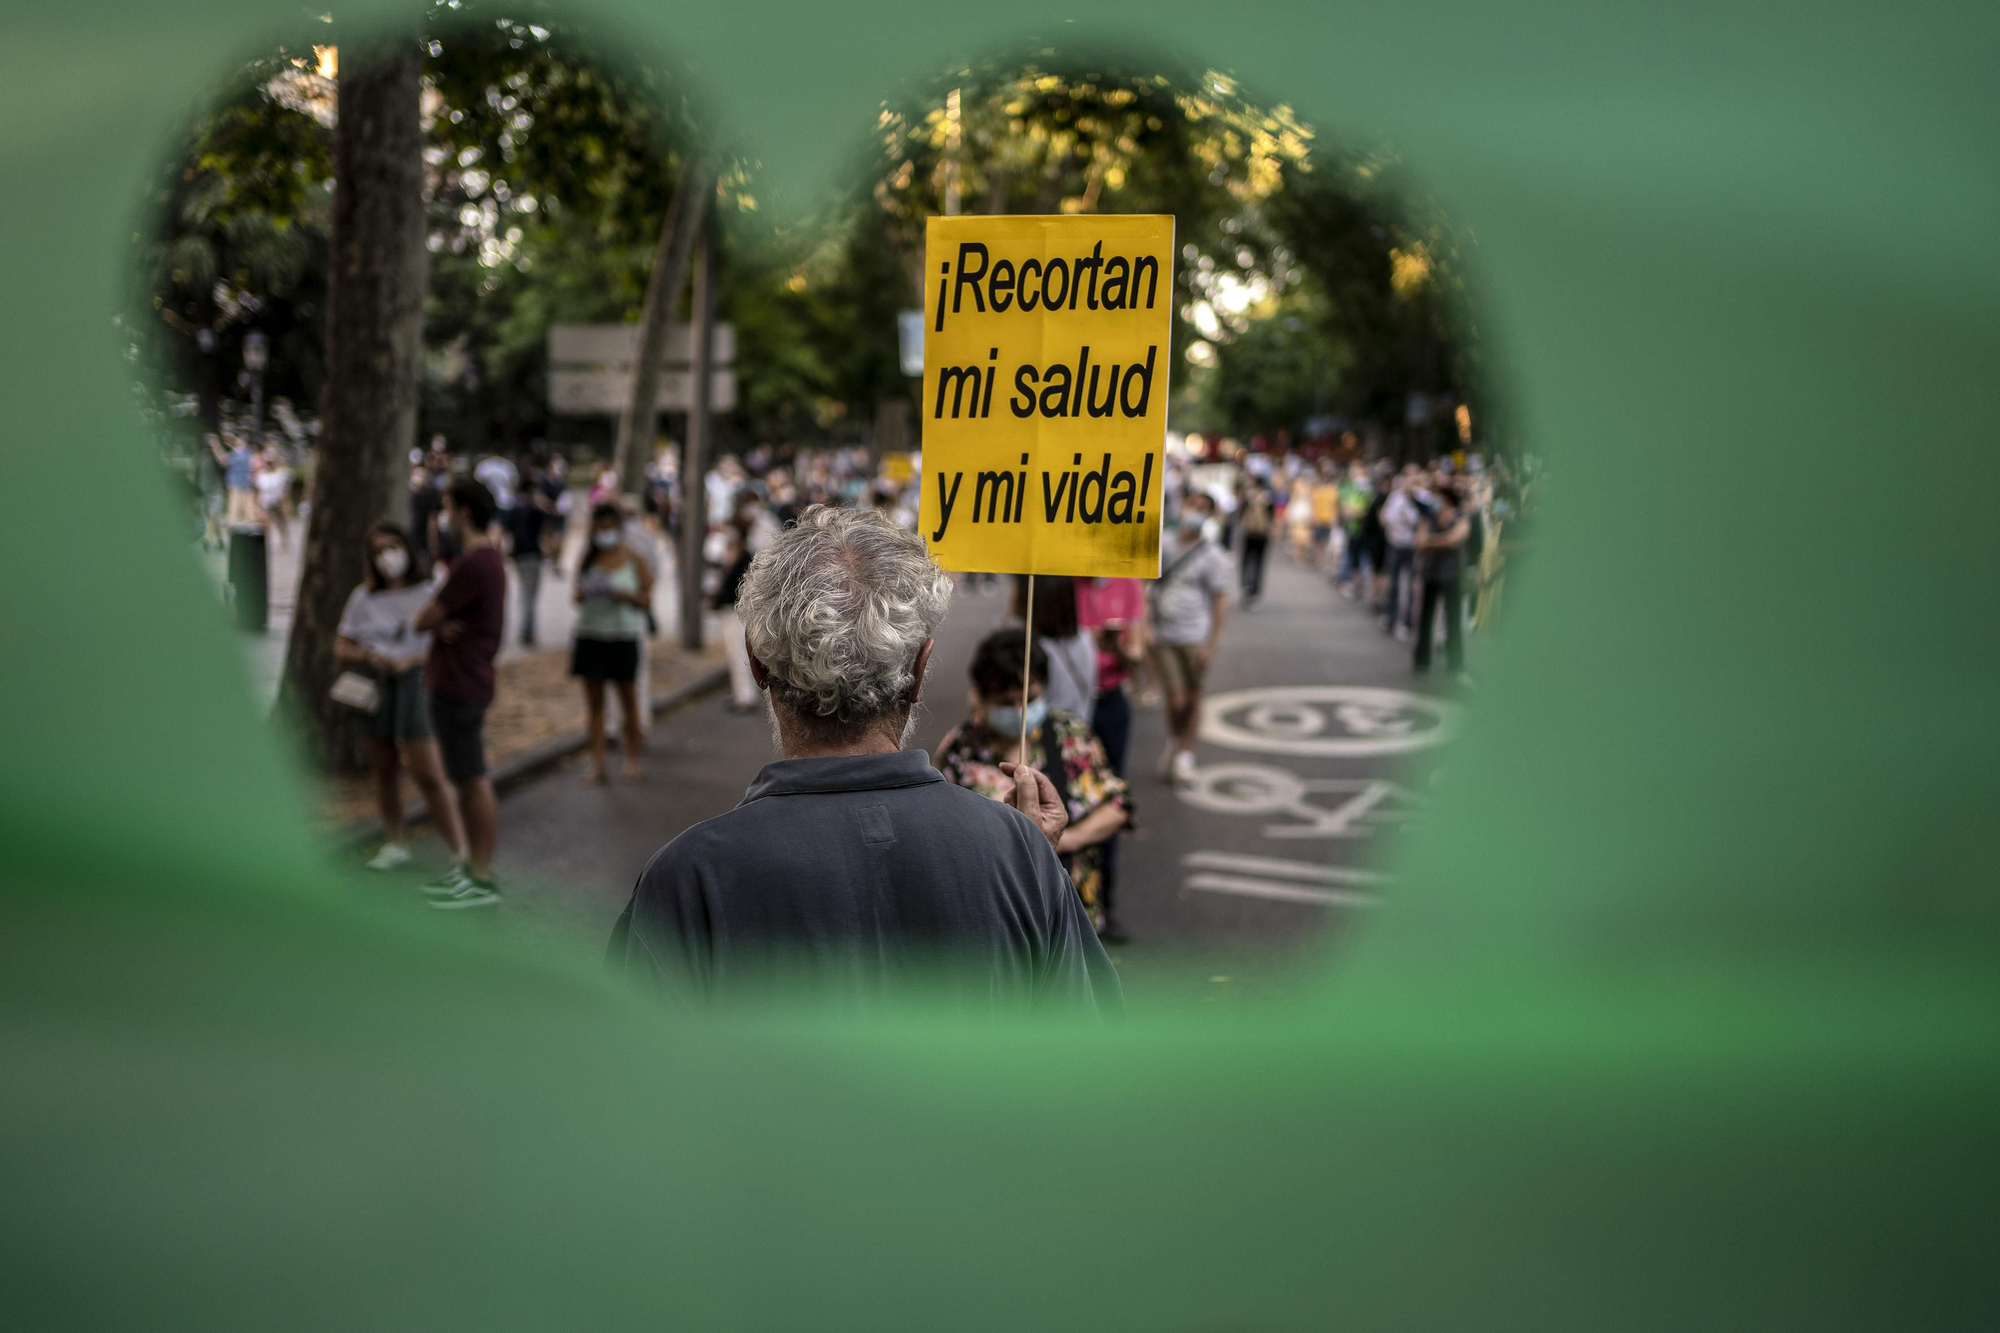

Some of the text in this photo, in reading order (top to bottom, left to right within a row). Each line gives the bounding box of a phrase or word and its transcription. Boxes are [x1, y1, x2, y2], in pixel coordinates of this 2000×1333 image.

[935, 240, 1159, 332] ¡Recortan
[934, 345, 1157, 419] mi salud
[932, 452, 1154, 543] y mi vida!
